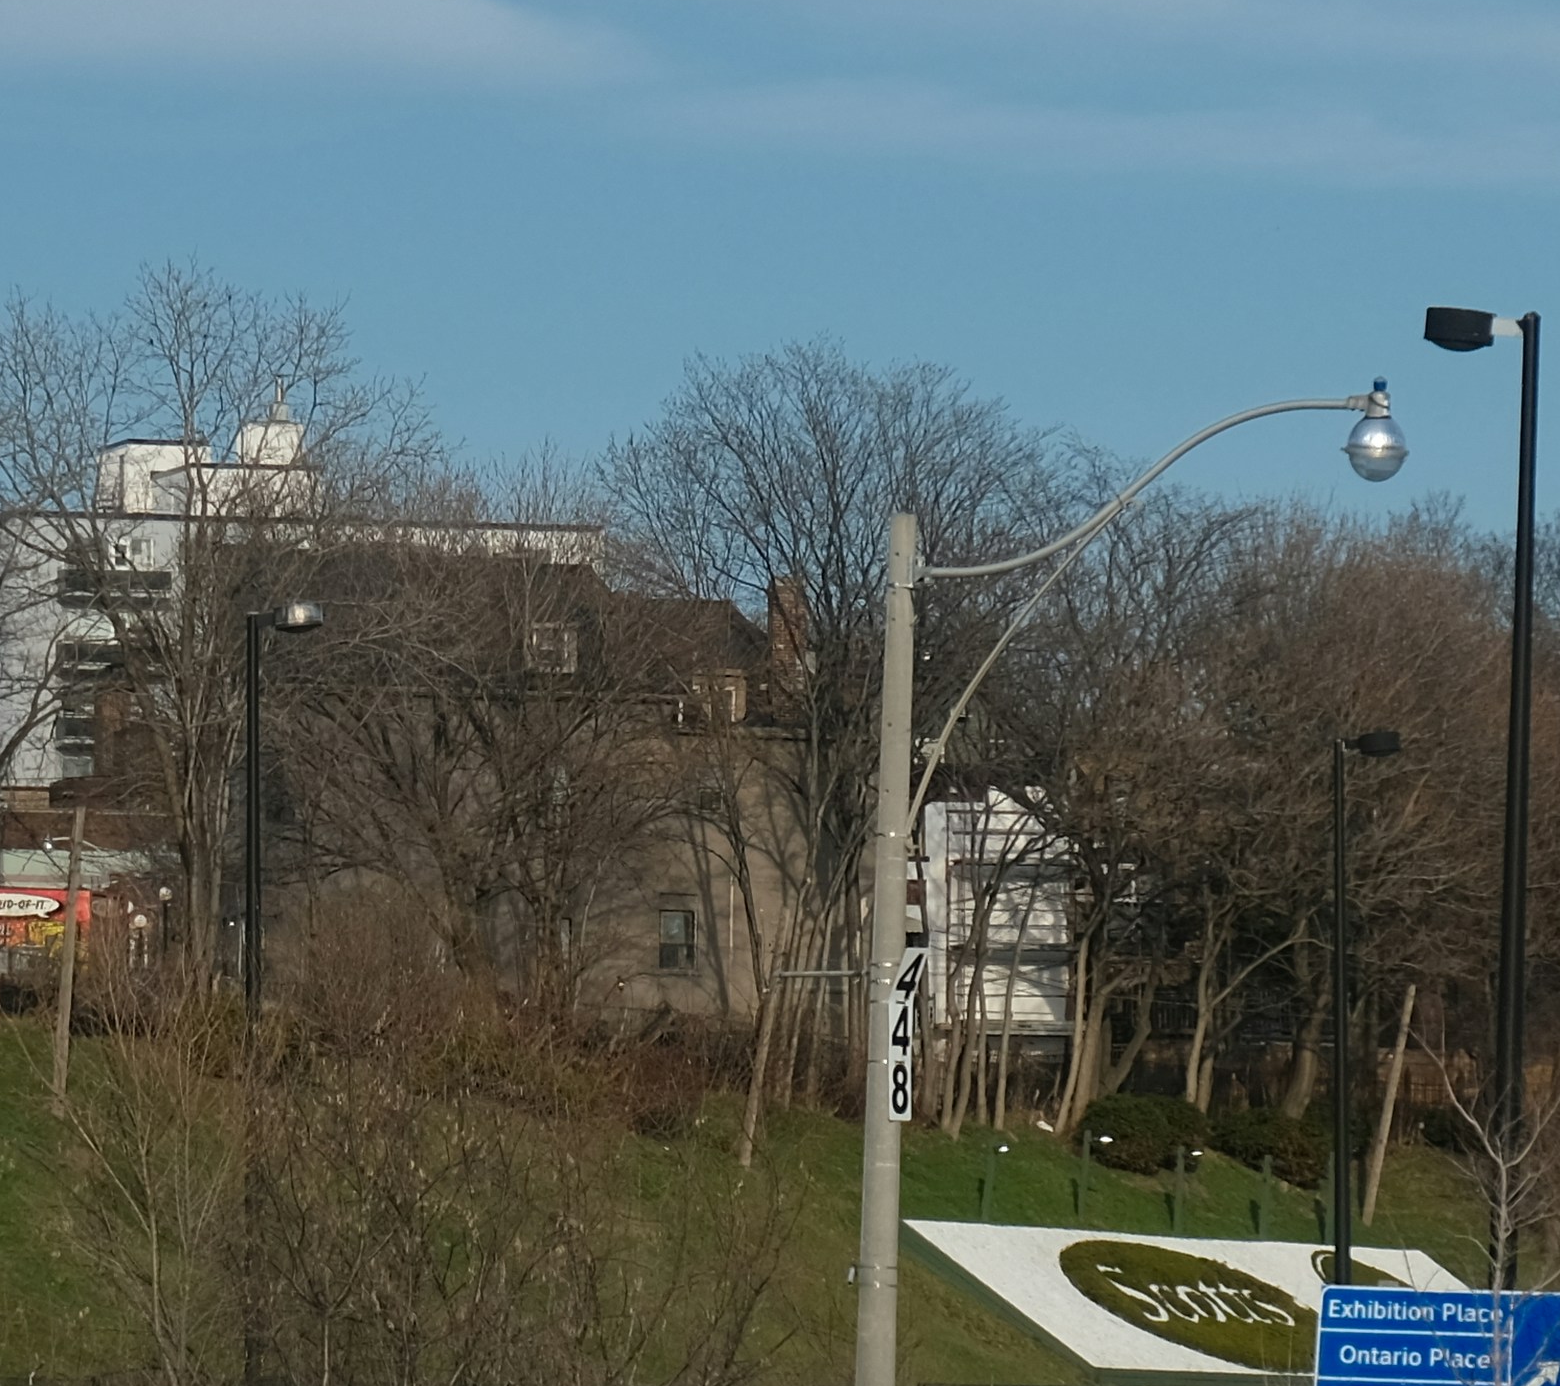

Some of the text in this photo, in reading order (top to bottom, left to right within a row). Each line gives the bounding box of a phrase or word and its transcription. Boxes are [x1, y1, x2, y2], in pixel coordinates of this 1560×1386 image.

[891, 953, 924, 1115] 448
[1096, 1264, 1296, 1327] Scotts
[1328, 1299, 1503, 1324] Exhibition Place
[1339, 1344, 1491, 1370] Ontario Place
